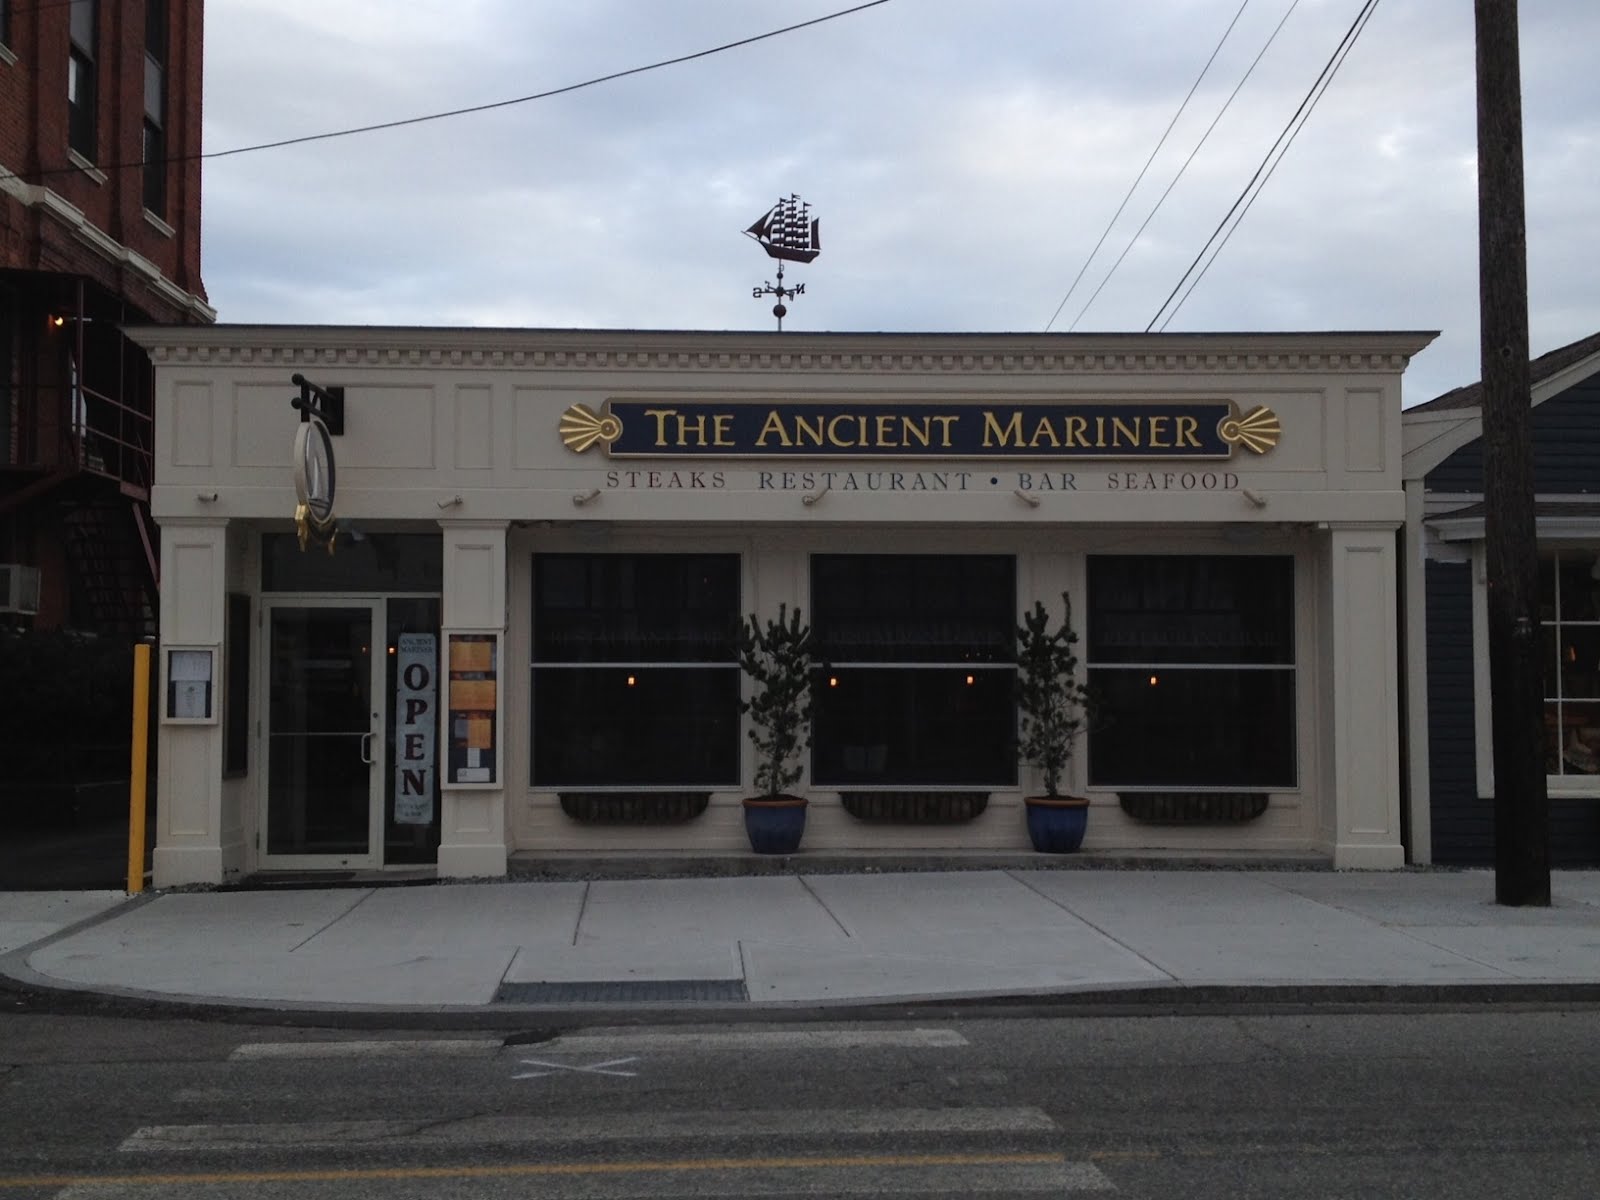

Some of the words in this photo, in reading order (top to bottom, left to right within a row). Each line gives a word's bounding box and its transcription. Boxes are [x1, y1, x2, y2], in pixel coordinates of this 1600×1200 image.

[644, 409, 736, 447] THE
[754, 410, 960, 447] ANCIENT
[982, 411, 1203, 448] MARINER
[606, 471, 726, 489] STEAKS
[759, 472, 972, 490] RESTAURANT
[1018, 473, 1079, 491] BAR
[1107, 472, 1240, 490] SEAFOOD
[402, 663, 430, 796] OPEN
